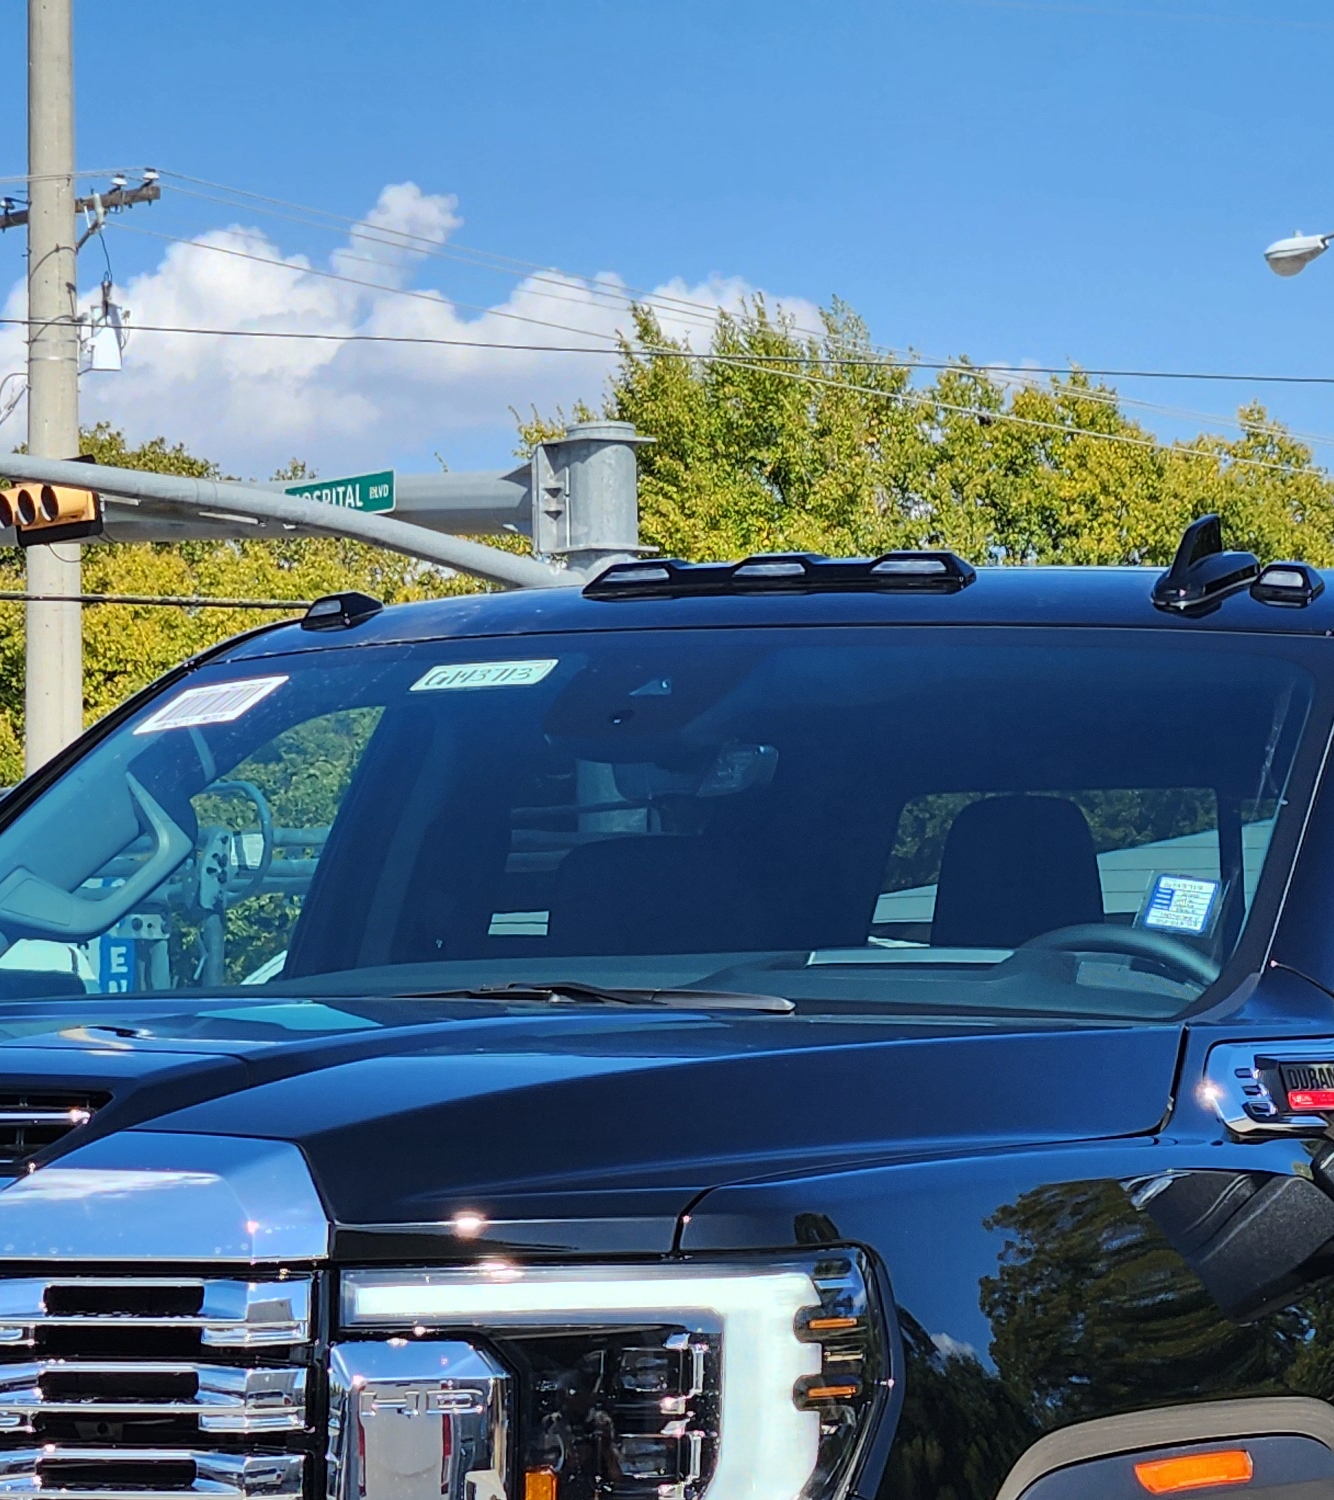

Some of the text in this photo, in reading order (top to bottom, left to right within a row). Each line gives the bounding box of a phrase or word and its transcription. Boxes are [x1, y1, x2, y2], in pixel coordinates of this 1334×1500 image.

[295, 483, 389, 507] SPITAL BLVD
[360, 1388, 485, 1418] HD
